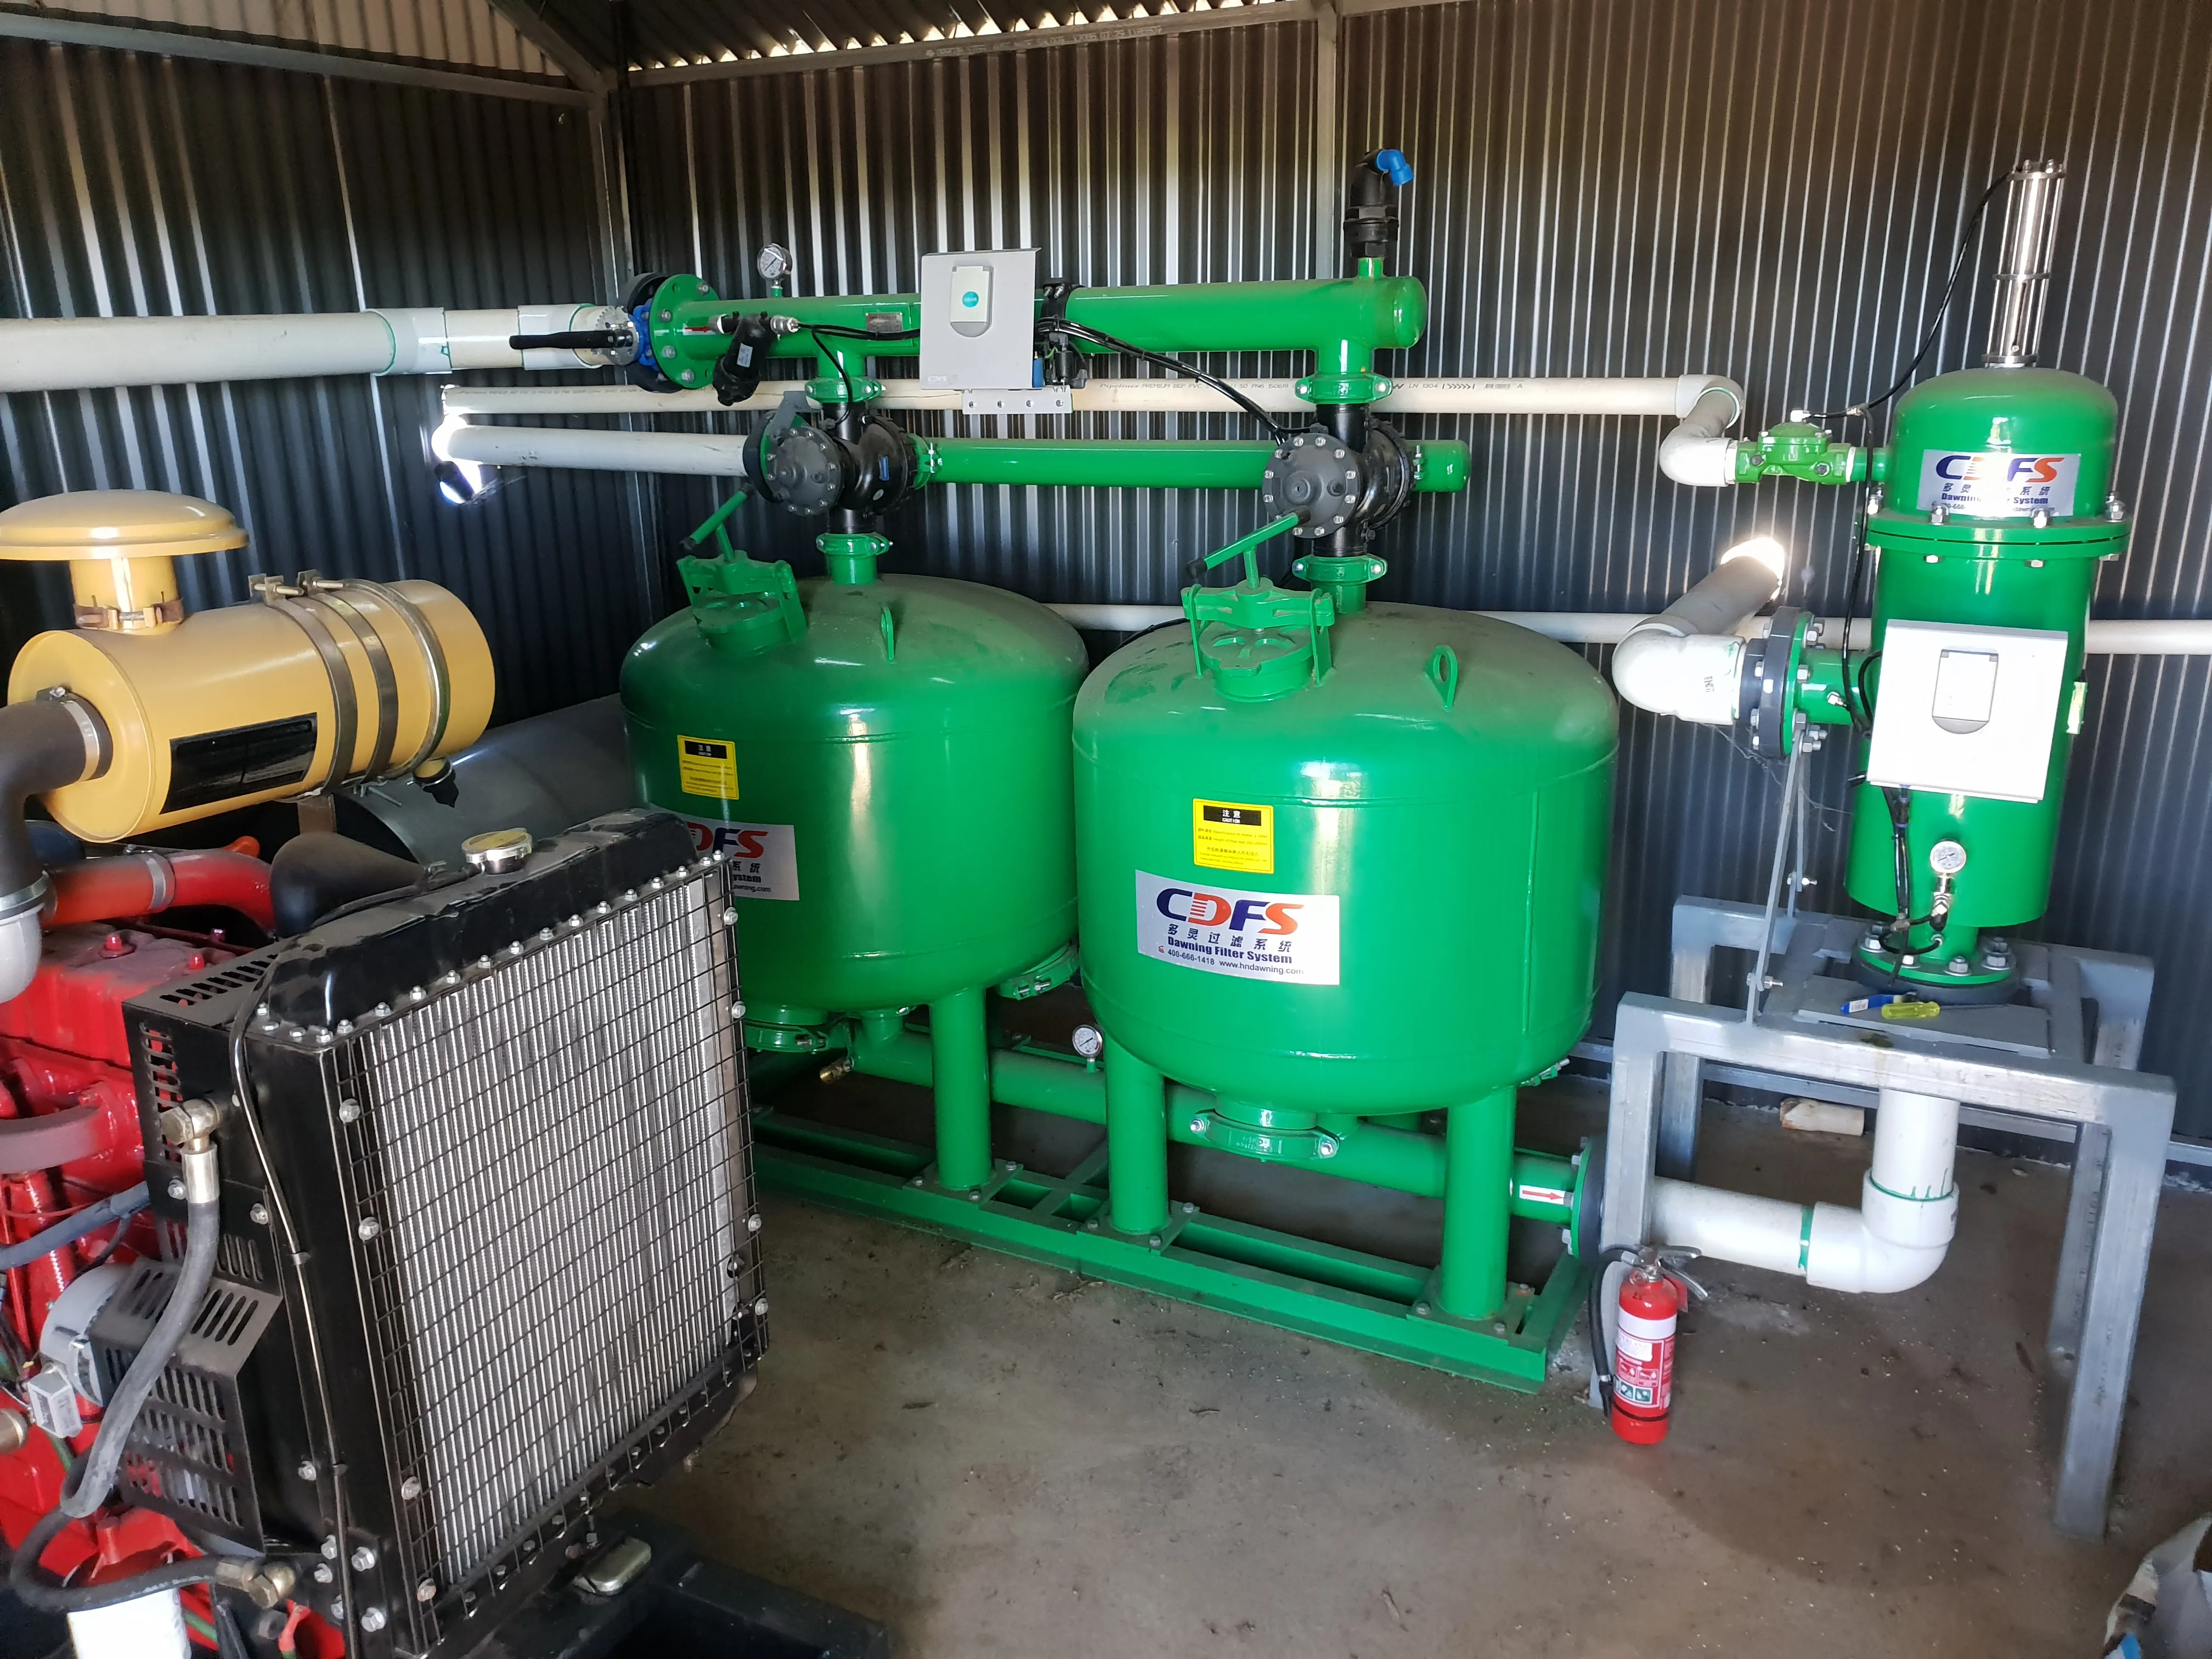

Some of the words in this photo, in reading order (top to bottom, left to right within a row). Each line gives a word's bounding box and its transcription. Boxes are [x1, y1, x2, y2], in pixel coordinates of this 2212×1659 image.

[1222, 809, 1241, 818] 注意
[687, 822, 769, 859] DFS
[733, 874, 761, 883] ystem
[1156, 888, 1304, 935] CDFS
[1167, 923, 1293, 952] 多灵过滤系统
[1167, 936, 1212, 955] Dawning
[1215, 946, 1244, 958] Filter
[1247, 951, 1292, 964] System
[1167, 949, 1215, 966] 400-666-1418
[1219, 960, 1304, 975] www.hndawning.com
